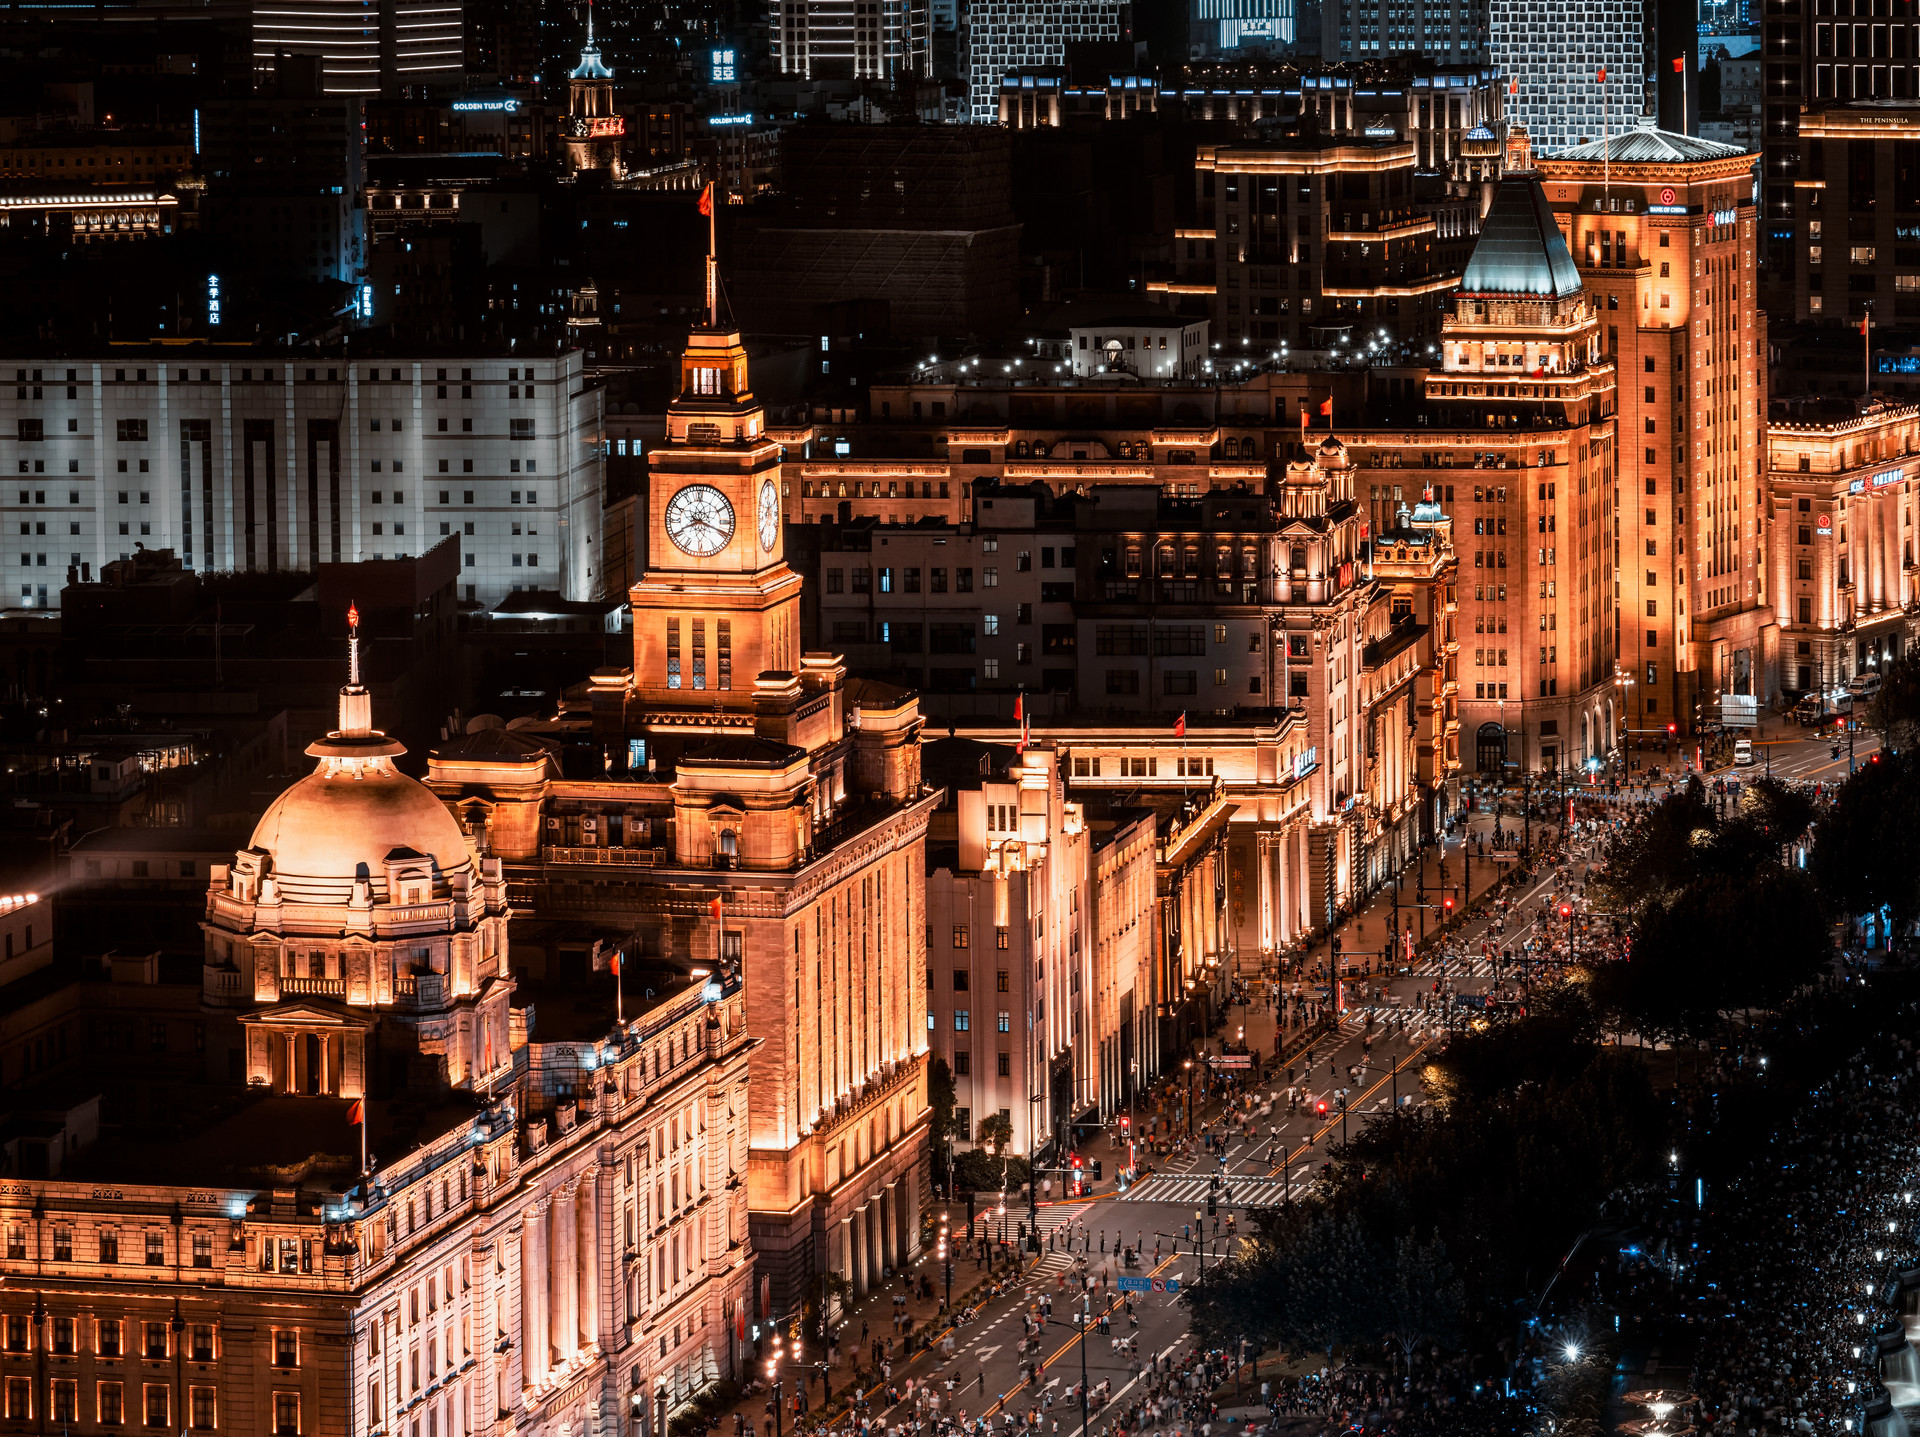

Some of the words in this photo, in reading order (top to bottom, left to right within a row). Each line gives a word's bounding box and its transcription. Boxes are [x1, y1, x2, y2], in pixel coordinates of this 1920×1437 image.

[484, 102, 503, 110] TULIP
[208, 275, 219, 323] 全季酒店
[1850, 480, 1865, 492] ICBC
